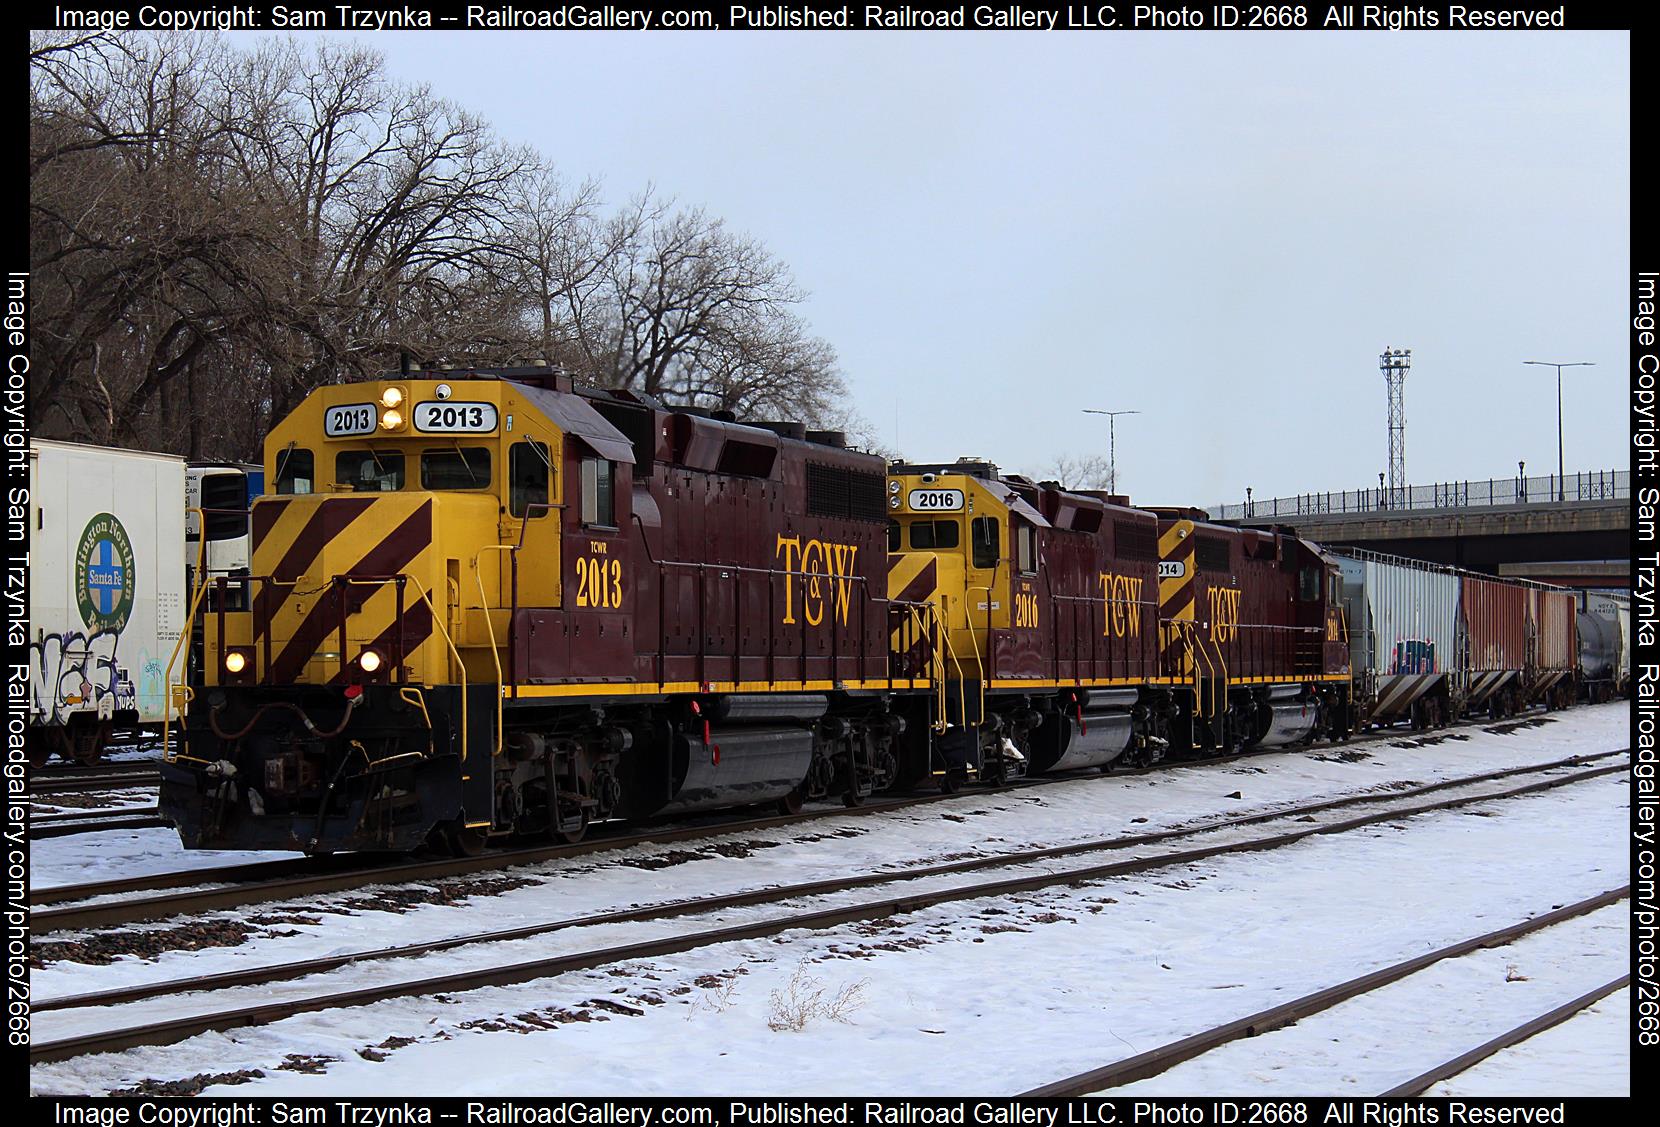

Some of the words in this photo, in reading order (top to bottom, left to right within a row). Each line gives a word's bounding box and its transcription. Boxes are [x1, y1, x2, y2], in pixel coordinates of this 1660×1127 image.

[334, 409, 369, 431] 2013
[428, 407, 483, 427] 2013
[919, 493, 954, 507] 2016
[590, 541, 607, 554] TCWR
[77, 521, 108, 605] Burlington
[109, 519, 133, 601] Northern
[89, 569, 113, 586] Santa
[114, 570, 122, 586] Fe
[576, 556, 622, 609] 2013
[87, 609, 125, 631] Railay
[1015, 592, 1039, 629] 2016
